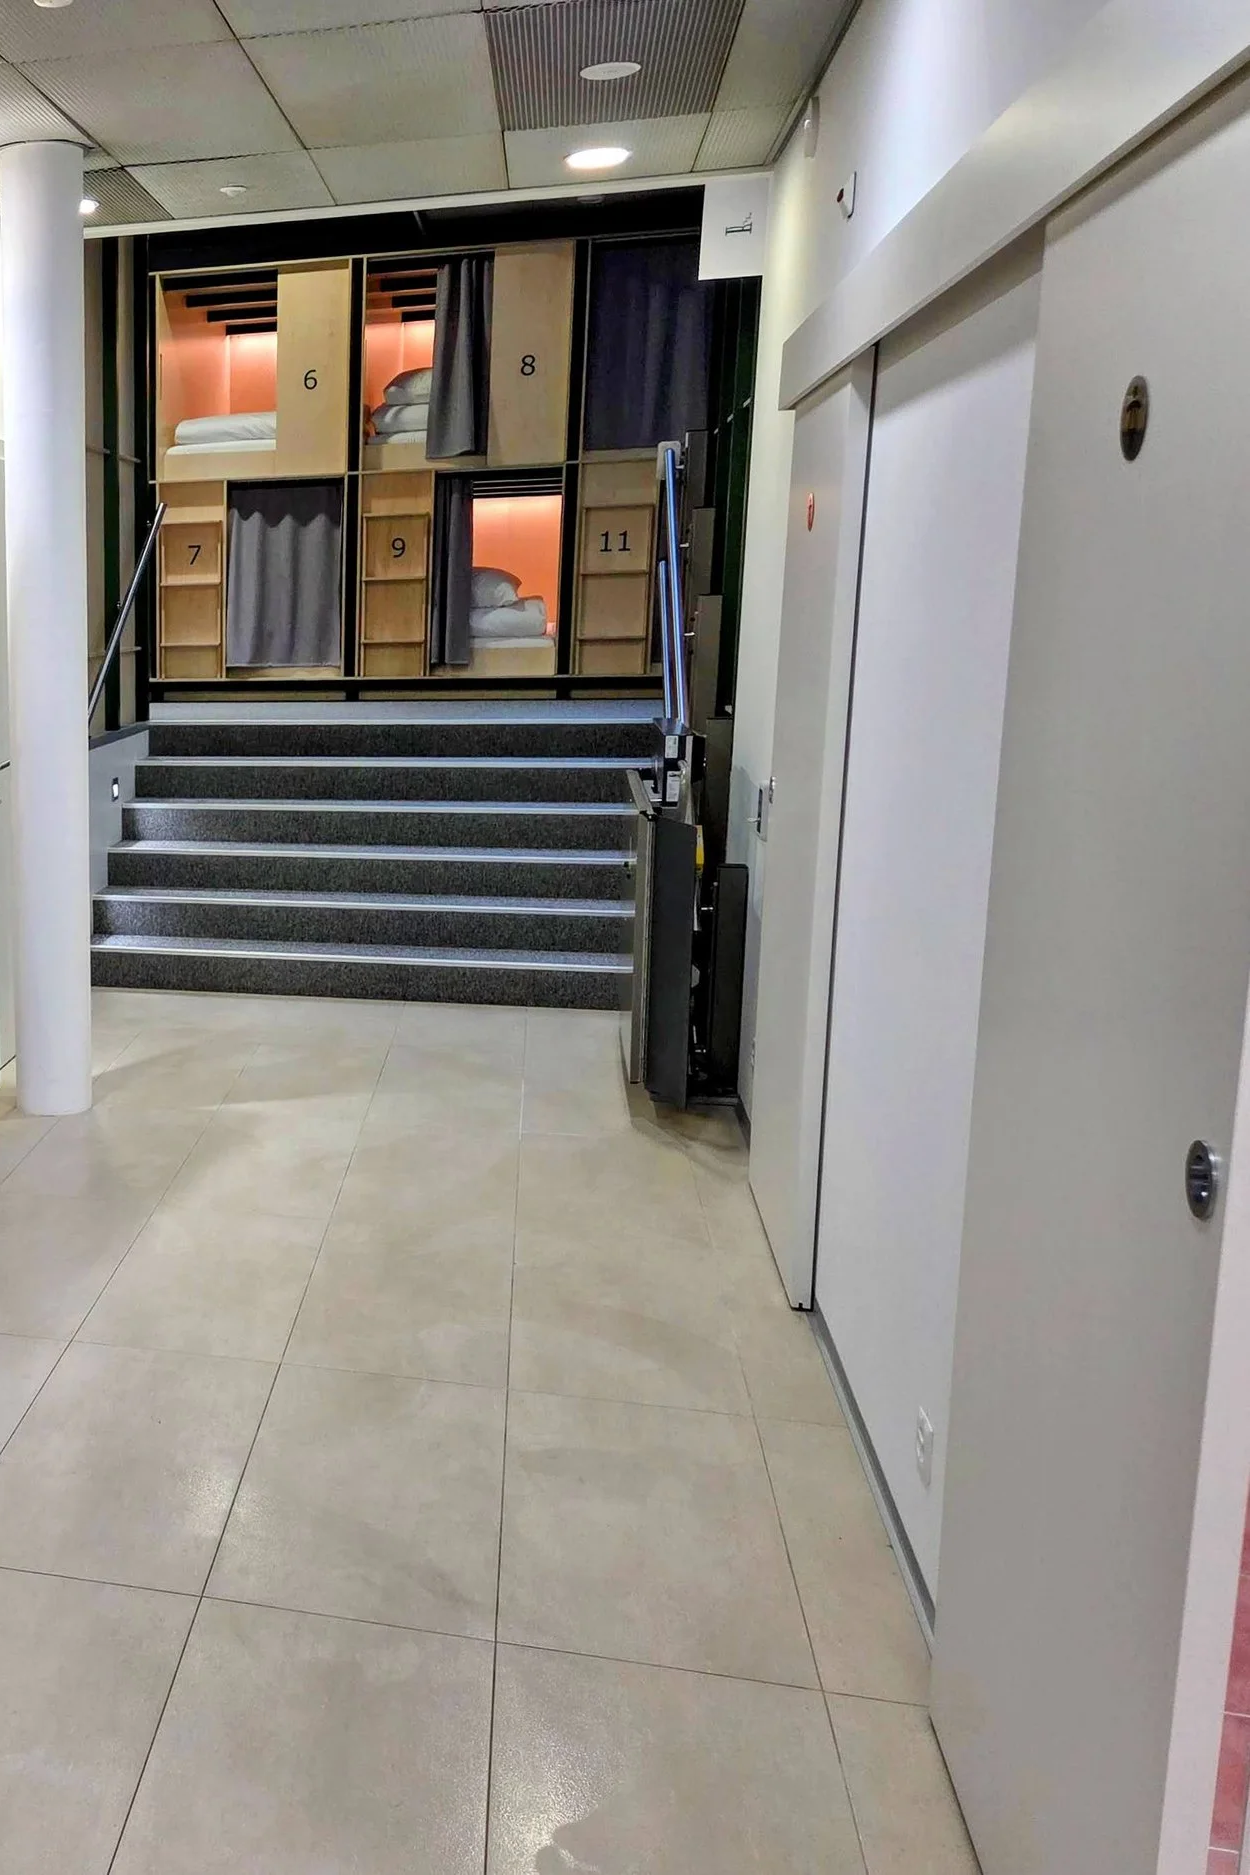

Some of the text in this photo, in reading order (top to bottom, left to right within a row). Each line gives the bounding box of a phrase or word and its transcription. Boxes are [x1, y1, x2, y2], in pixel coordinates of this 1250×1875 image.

[520, 354, 536, 377] 8
[303, 369, 318, 390] 6
[391, 537, 406, 559] 9
[599, 530, 631, 553] 11
[187, 544, 202, 565] 7
